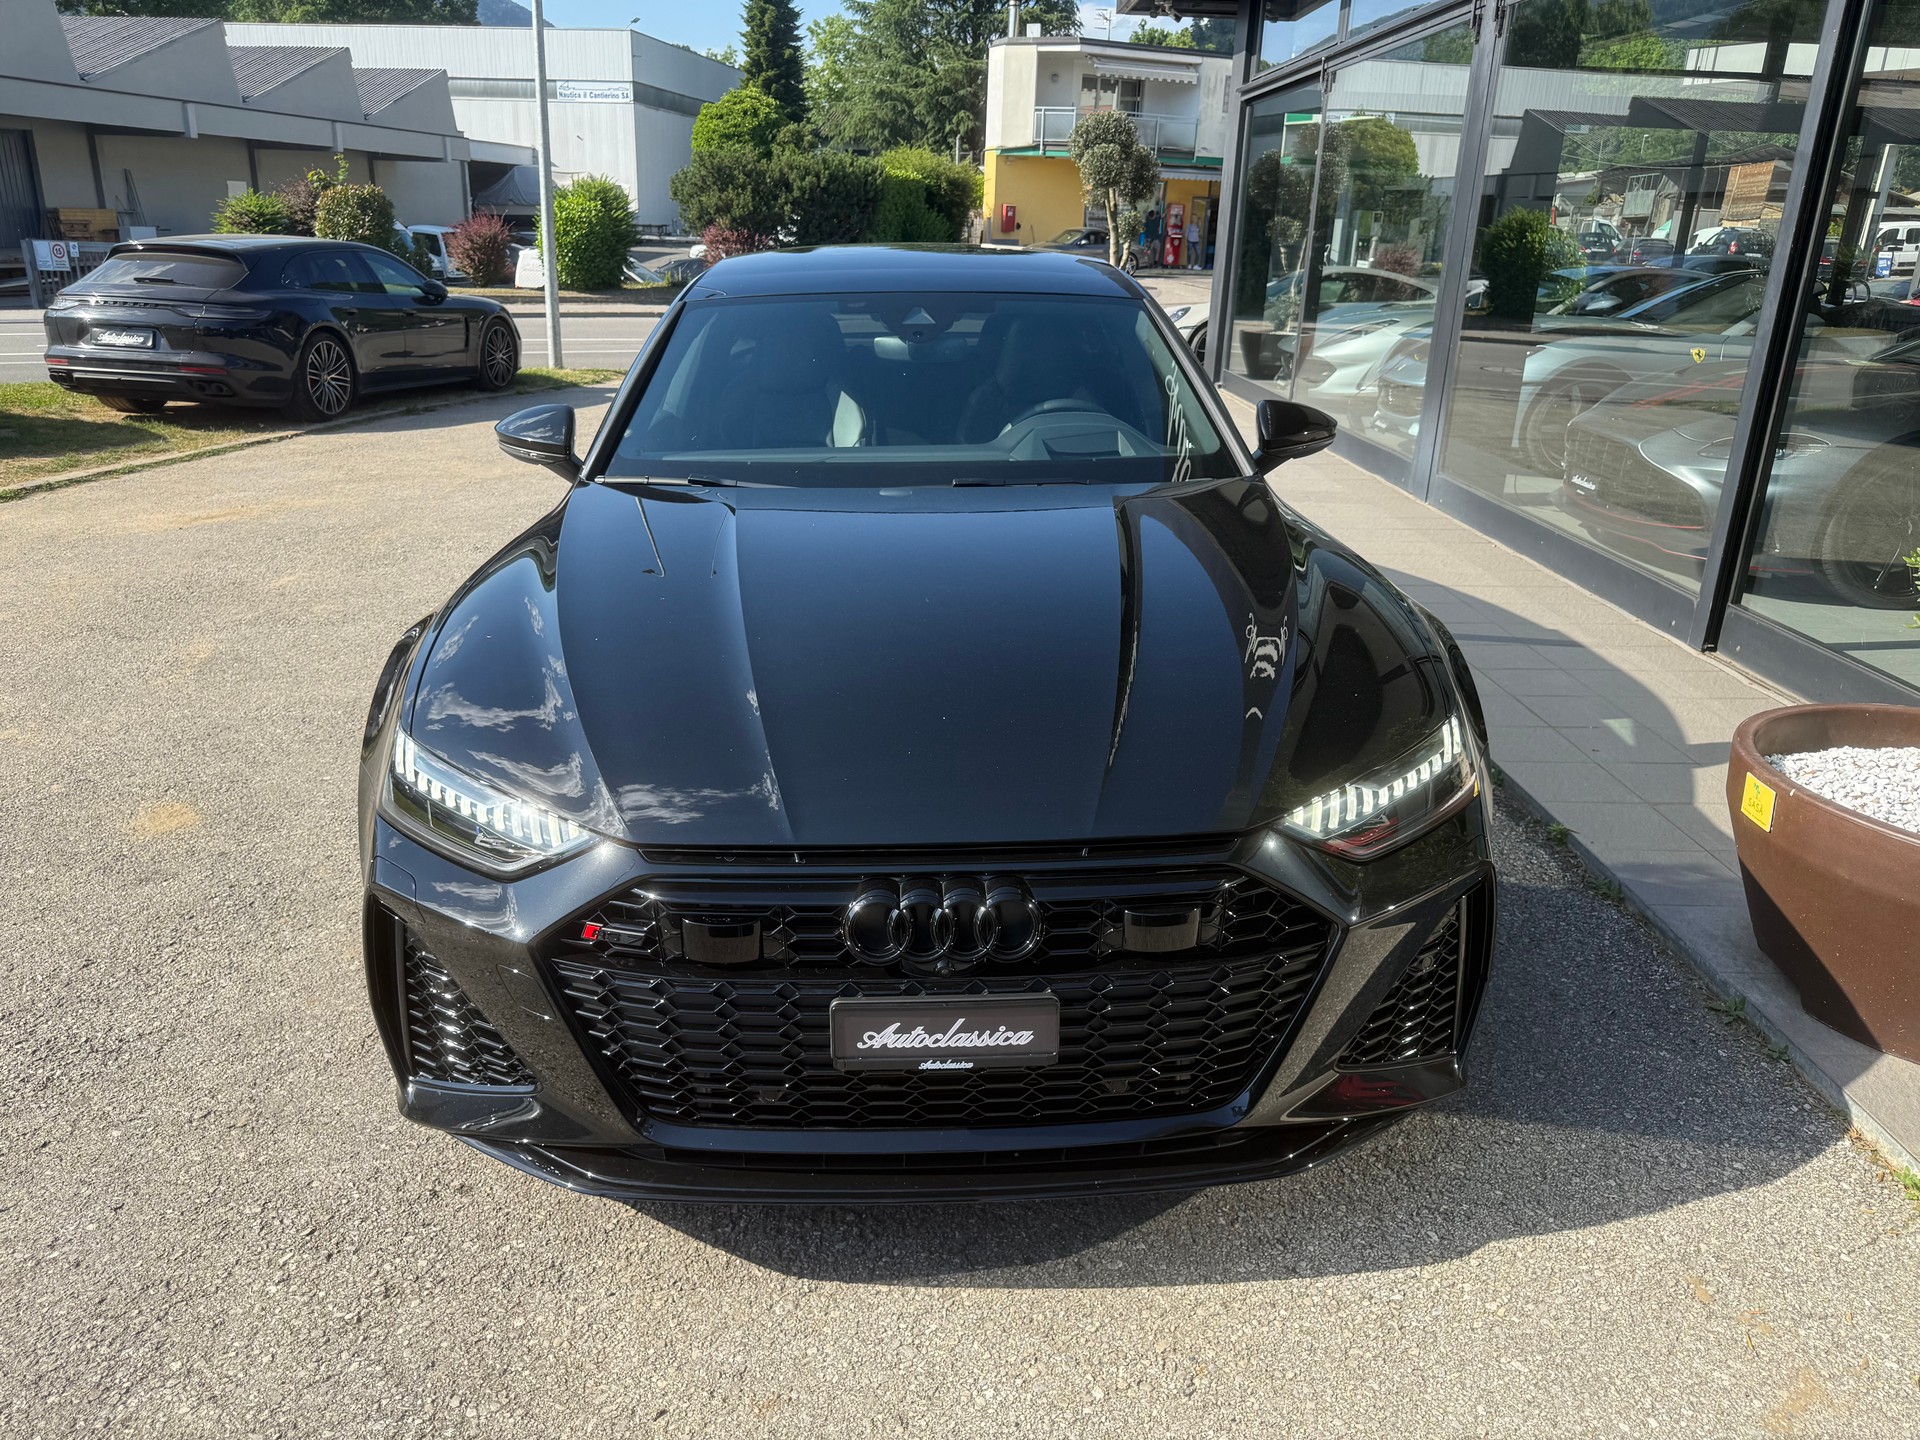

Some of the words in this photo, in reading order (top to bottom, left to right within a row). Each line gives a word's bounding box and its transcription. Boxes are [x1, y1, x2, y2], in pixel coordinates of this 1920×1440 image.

[558, 91, 581, 99] Nautica
[589, 91, 620, 99] Cantierino
[856, 1018, 1034, 1049] Autoclassica
[918, 1058, 974, 1070] Autoclassica
